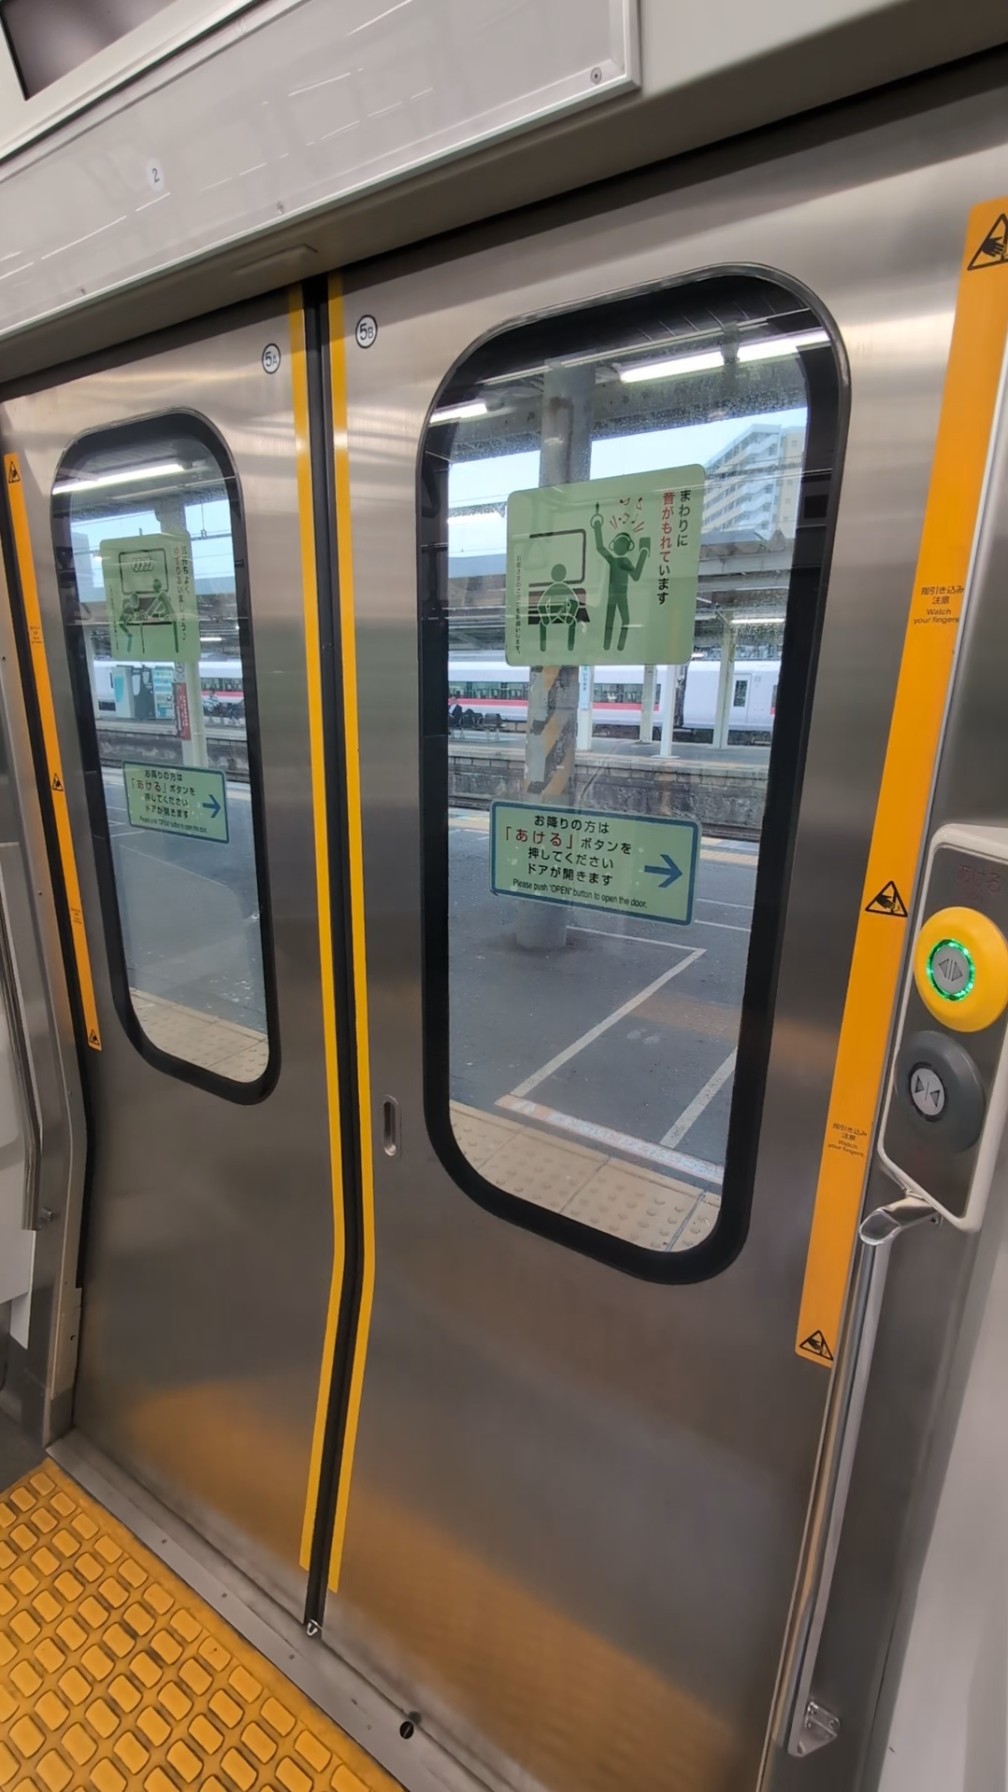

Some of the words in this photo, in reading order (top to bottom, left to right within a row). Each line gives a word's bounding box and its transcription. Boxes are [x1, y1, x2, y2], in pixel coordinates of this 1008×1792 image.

[152, 168, 160, 183] 2
[359, 323, 374, 340] 5B
[265, 351, 278, 367] 5A
[676, 489, 692, 548] まわりに
[656, 491, 676, 606] 音がもれています
[921, 585, 965, 596] 指引き込み
[932, 596, 950, 605] 注意
[913, 617, 931, 625] your
[932, 616, 960, 625] fingers
[927, 608, 952, 616] Watch
[534, 815, 610, 834] お降りの方は
[528, 847, 614, 869] 押してください
[528, 863, 613, 886] ドアが開きます
[513, 878, 533, 889] Please
[534, 882, 548, 892] push
[573, 889, 593, 899] button
[601, 894, 618, 904] open
[619, 896, 630, 905] the
[630, 897, 647, 908] door.
